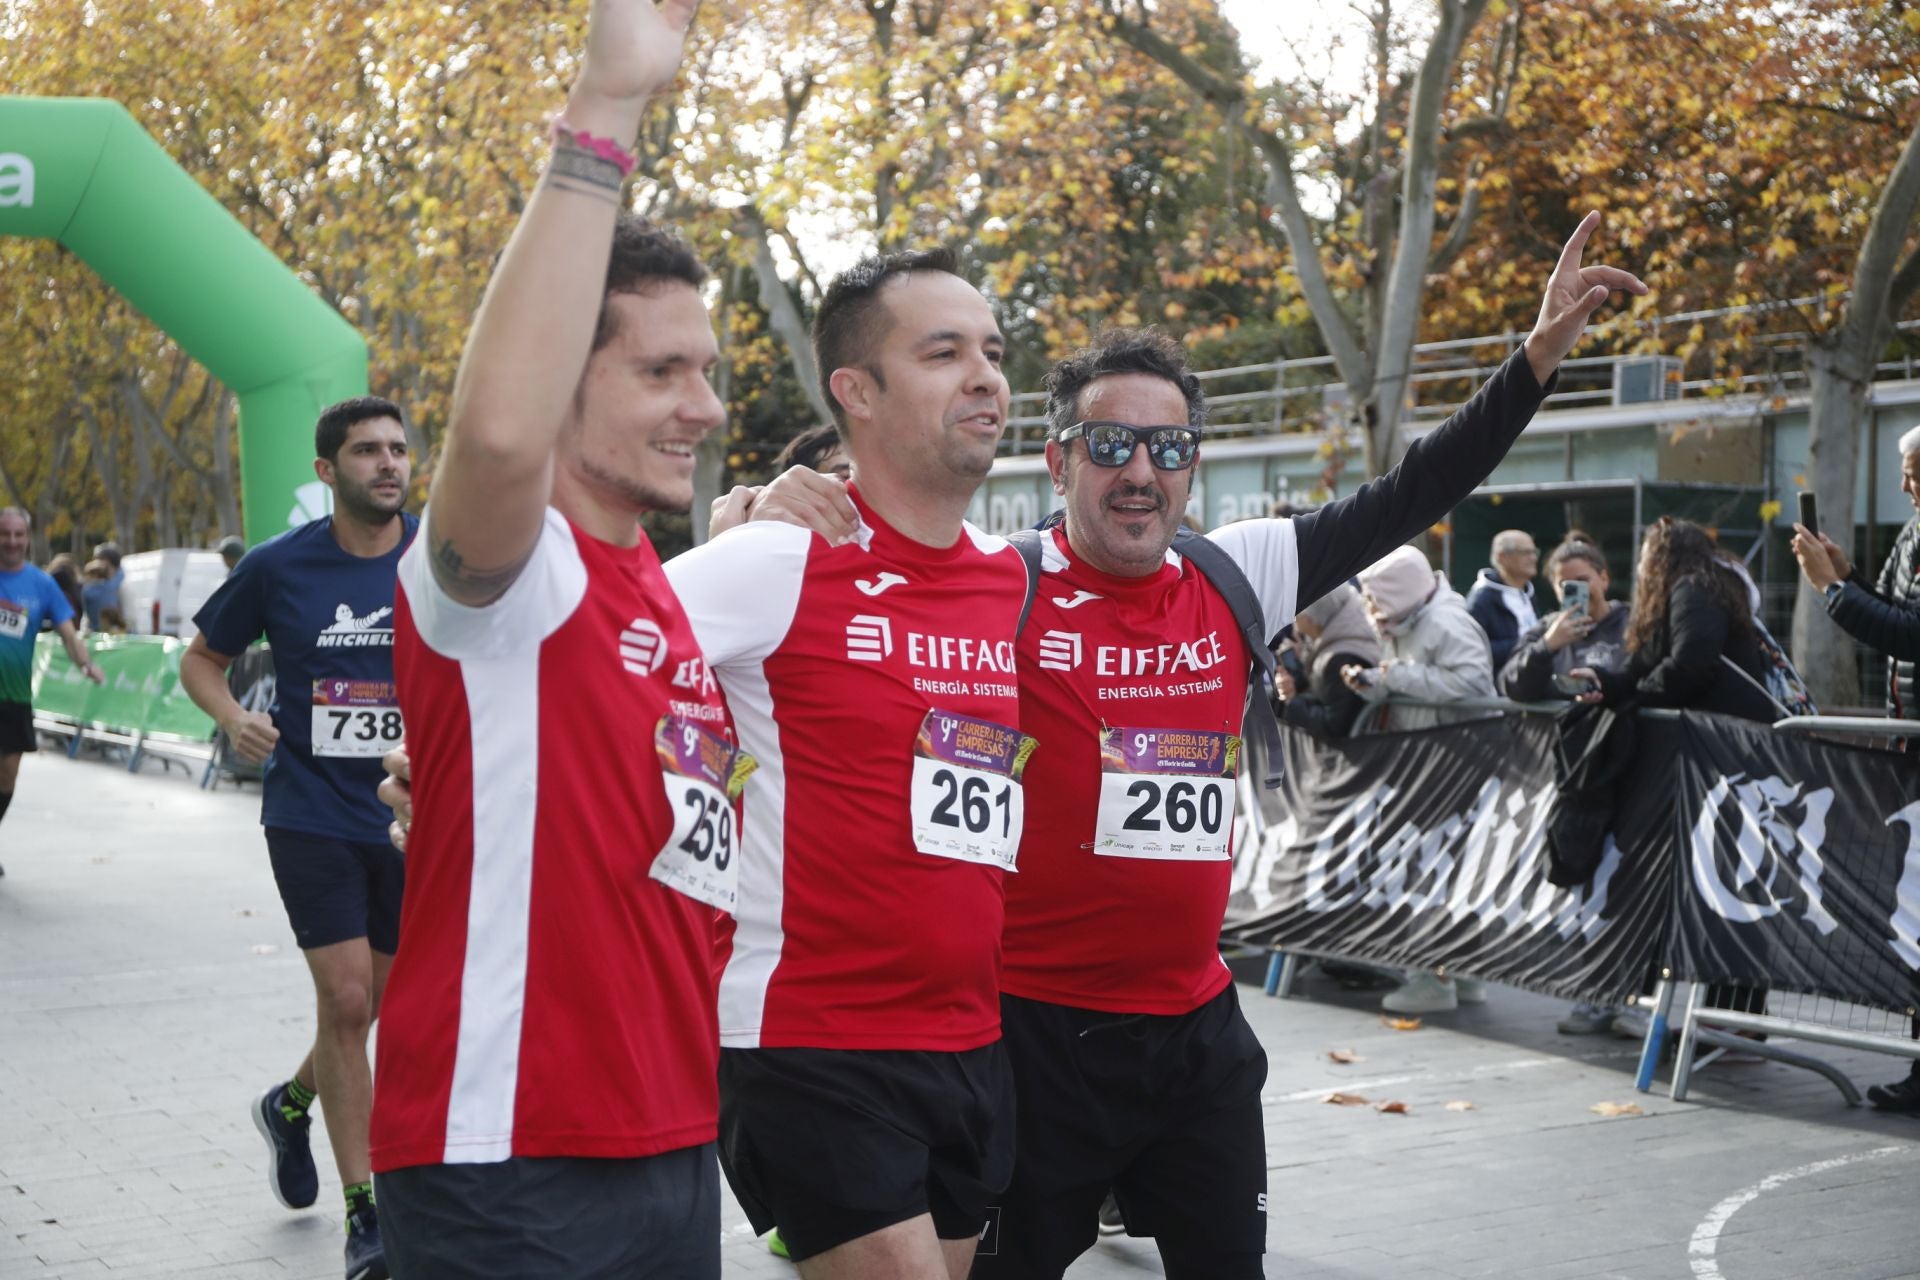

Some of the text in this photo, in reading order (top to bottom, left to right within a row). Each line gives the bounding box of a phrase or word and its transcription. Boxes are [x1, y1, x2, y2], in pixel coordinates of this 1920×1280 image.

[1097, 630, 1226, 676] EIFFAGE
[913, 677, 1018, 698] ENERGÍA SISTEMAS
[1098, 676, 1223, 699] ENERGÍA SISTEMAS
[328, 710, 403, 741] 738
[958, 721, 995, 740] CARRERA
[994, 730, 1005, 743] DE
[956, 733, 1004, 757] EMPRESAS
[1157, 733, 1197, 747] CARRERA
[1198, 736, 1209, 747] DE
[1157, 745, 1209, 760] EMPRESAS
[930, 769, 1011, 839] 261
[1122, 779, 1223, 834] 260
[678, 788, 731, 871] 259
